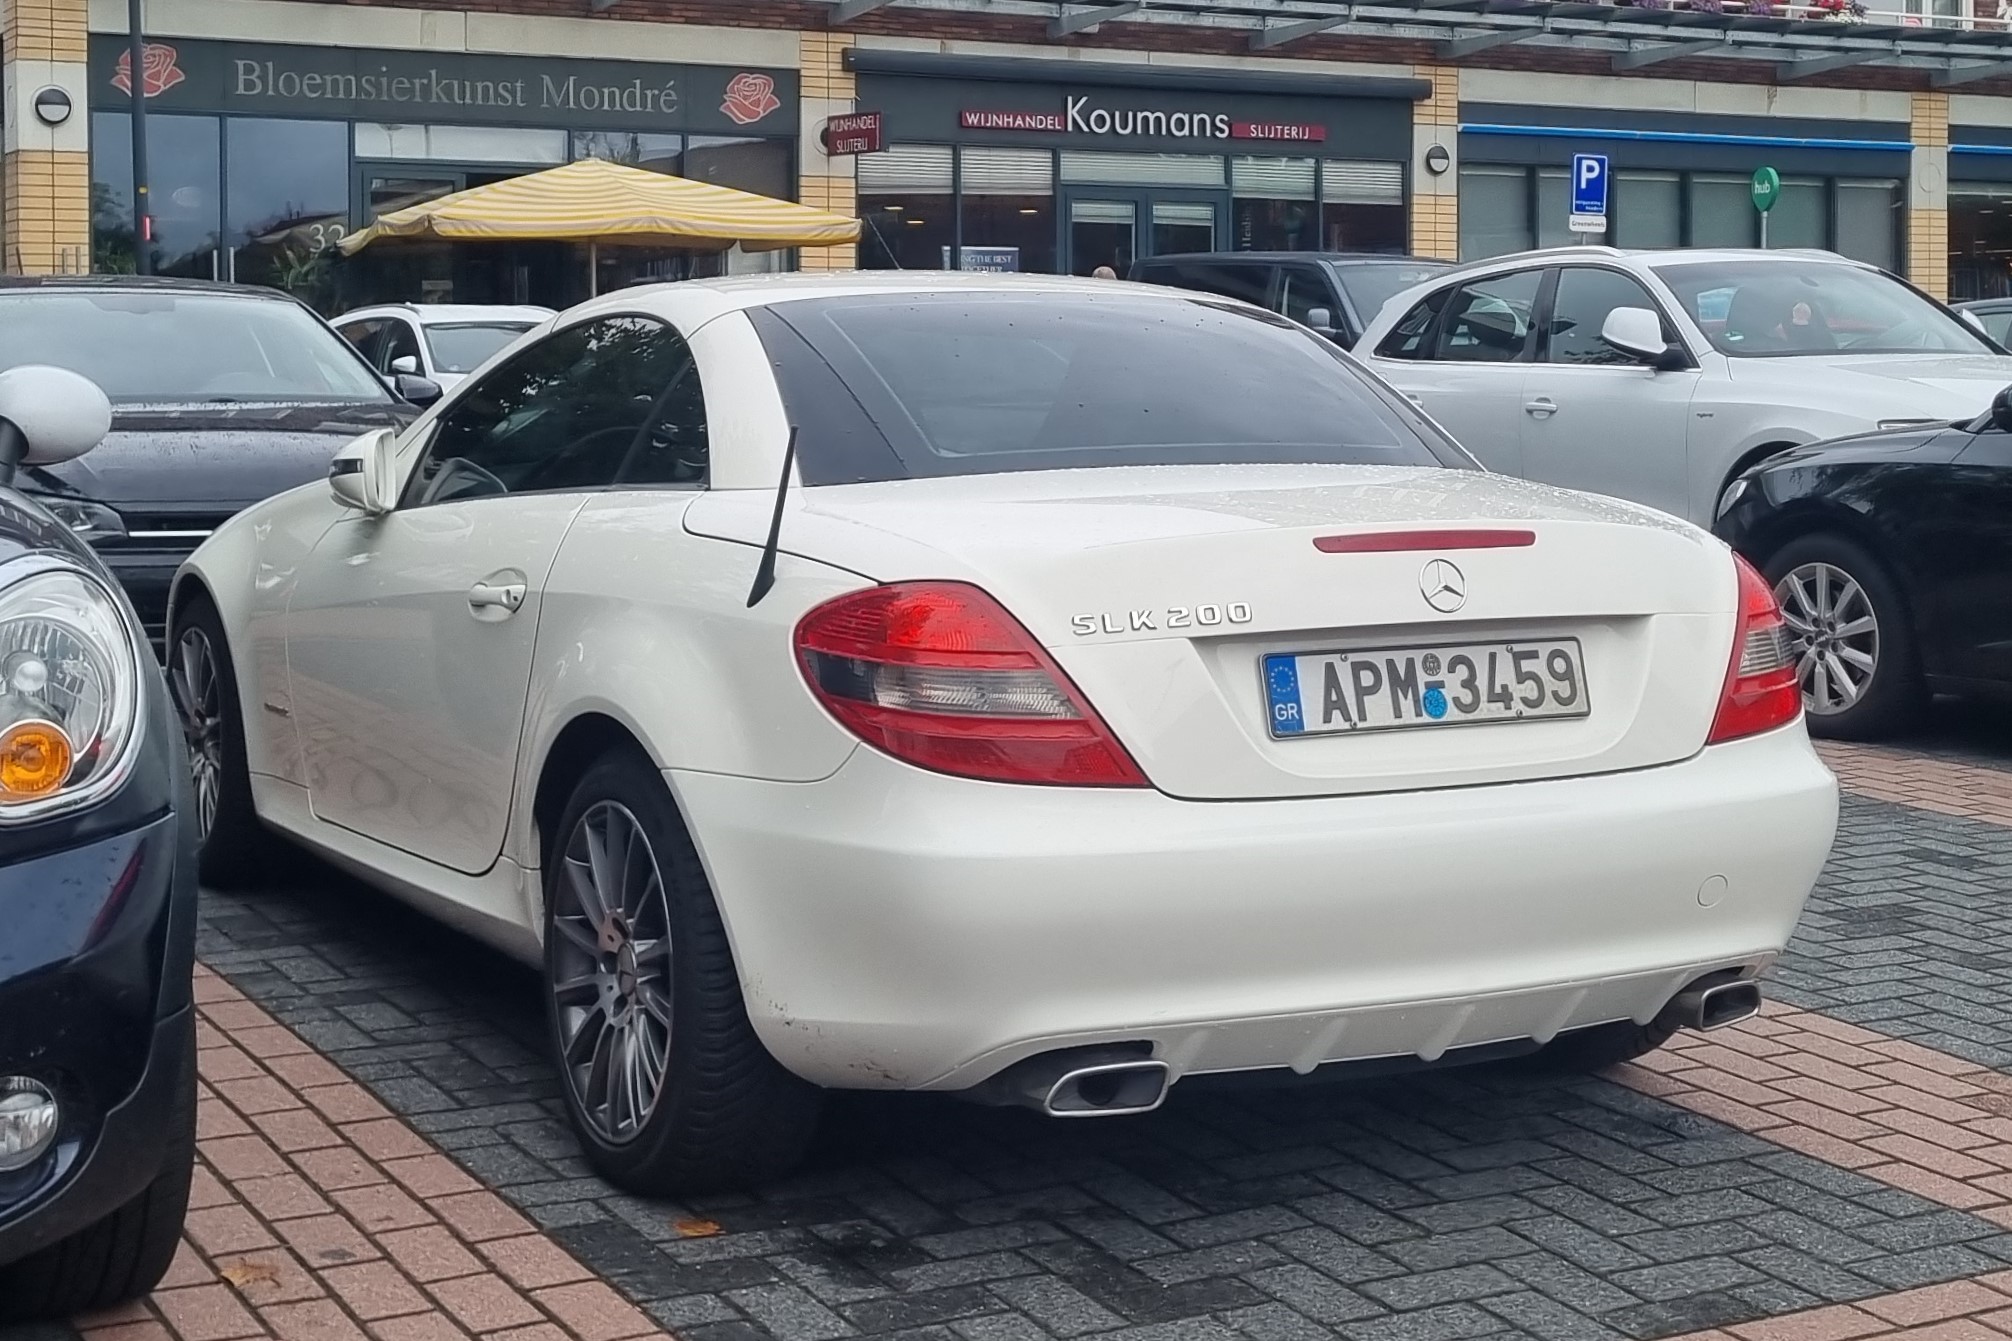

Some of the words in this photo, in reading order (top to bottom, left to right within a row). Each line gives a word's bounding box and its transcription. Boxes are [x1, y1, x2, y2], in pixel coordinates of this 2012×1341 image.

[234, 59, 527, 108] Bloemsierkunst
[540, 74, 678, 114] Mondré
[965, 111, 1062, 131] WIJNHANDEL
[1066, 96, 1230, 139] Koumans
[1249, 123, 1310, 140] SLIJTERIJ
[1580, 159, 1600, 190] P
[1754, 180, 1771, 195] hub
[1071, 609, 1158, 636] SLK
[1166, 601, 1253, 629] 200
[1275, 703, 1300, 721] GR
